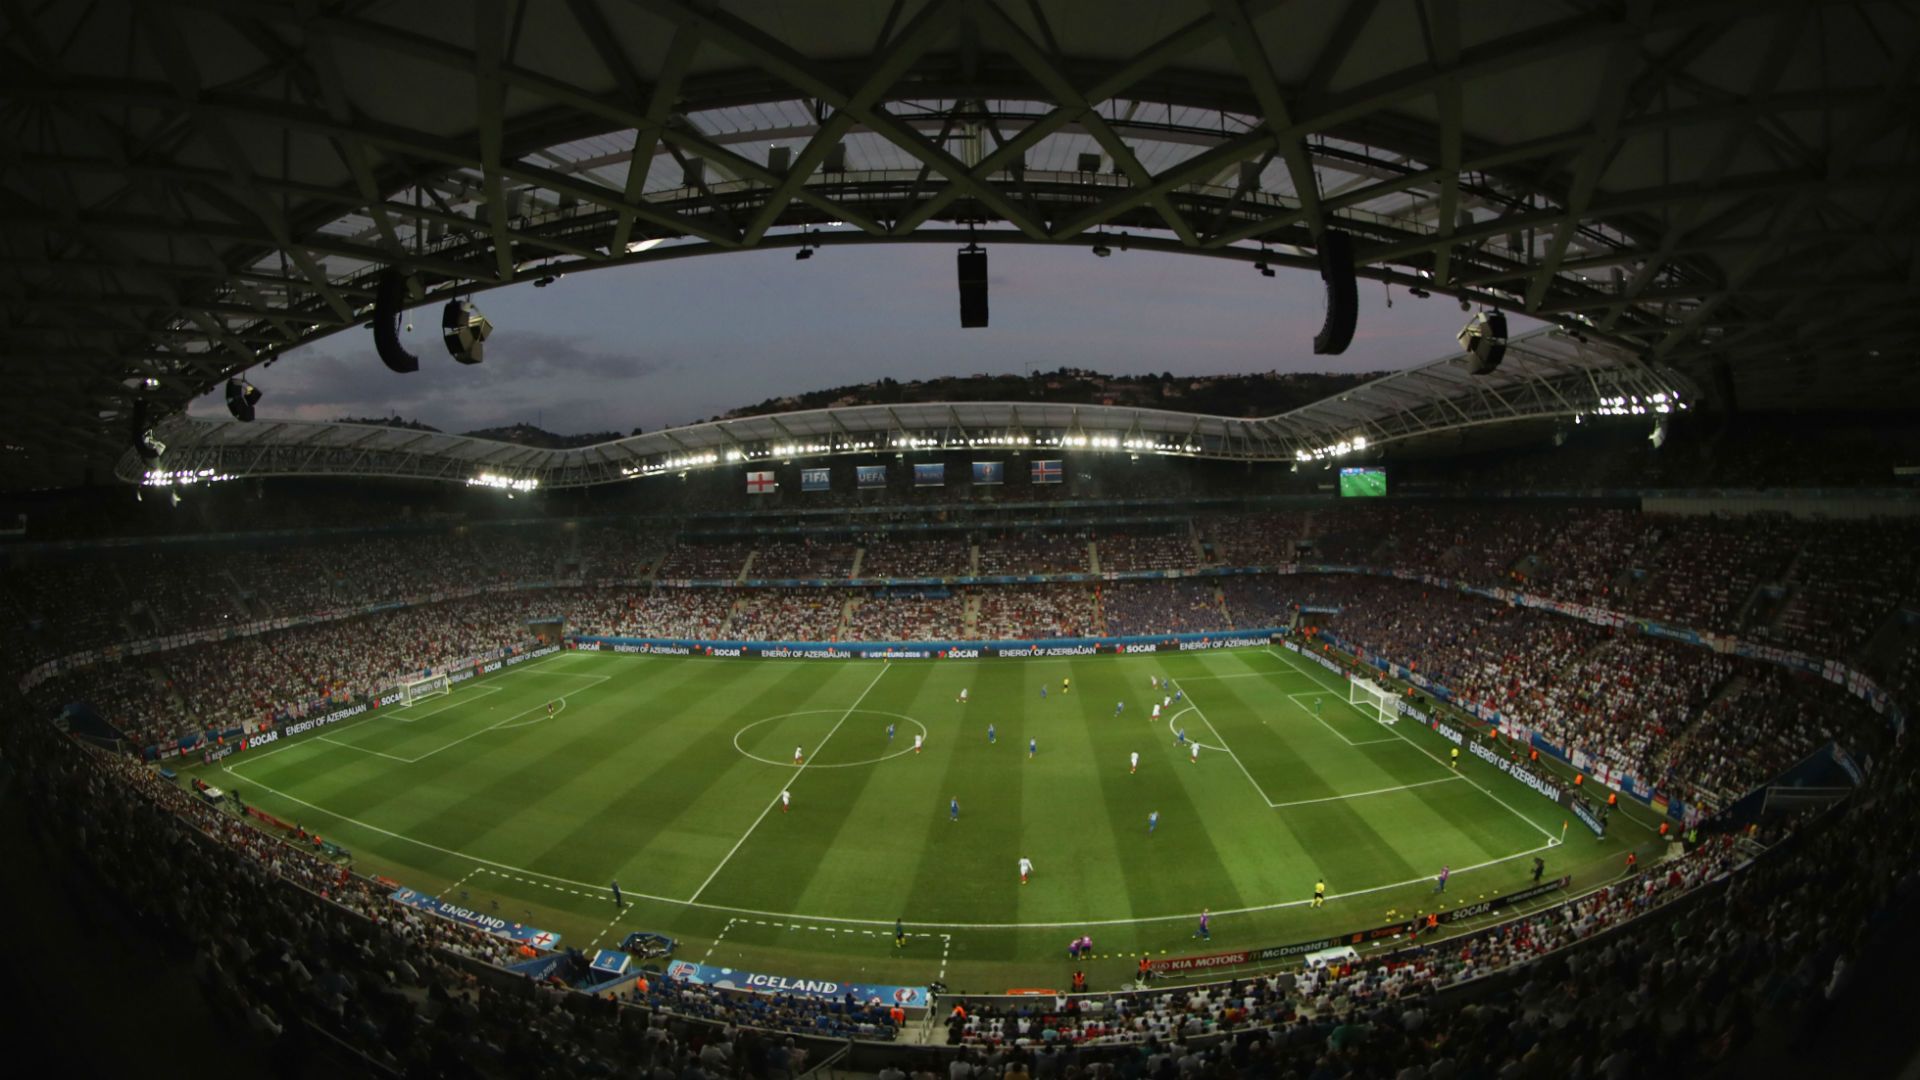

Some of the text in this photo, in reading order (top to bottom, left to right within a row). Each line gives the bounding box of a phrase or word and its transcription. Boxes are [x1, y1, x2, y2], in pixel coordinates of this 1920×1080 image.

[801, 472, 829, 483] FIFA
[858, 472, 885, 482] UEFA
[578, 643, 600, 651] SOCAR
[614, 645, 689, 655] ENERGY OF AZERBAIJAN
[1126, 644, 1156, 653] SOCAR
[1180, 638, 1270, 651] ENERGY OF AZERBAIJAN
[714, 648, 740, 657] SOCAR
[761, 650, 850, 659] ENERGY OF AZERBAIJAN
[948, 650, 979, 658] SOCAR
[999, 647, 1097, 657] ENERGY OF AZERBAIJAN
[285, 704, 367, 736] ENERGY OF AZERBAIJAN
[250, 731, 278, 748] SOCAR
[1439, 724, 1463, 746] SOCAR
[1469, 741, 1560, 802] ENERGY OF AZERBAIJAN
[440, 903, 505, 930] ENGLAND
[1452, 903, 1491, 921] SOCAR
[1262, 940, 1329, 959] McDonald's
[1172, 960, 1192, 969] KIA
[1195, 953, 1244, 968] MOTORS
[747, 974, 838, 994] ICELAND
